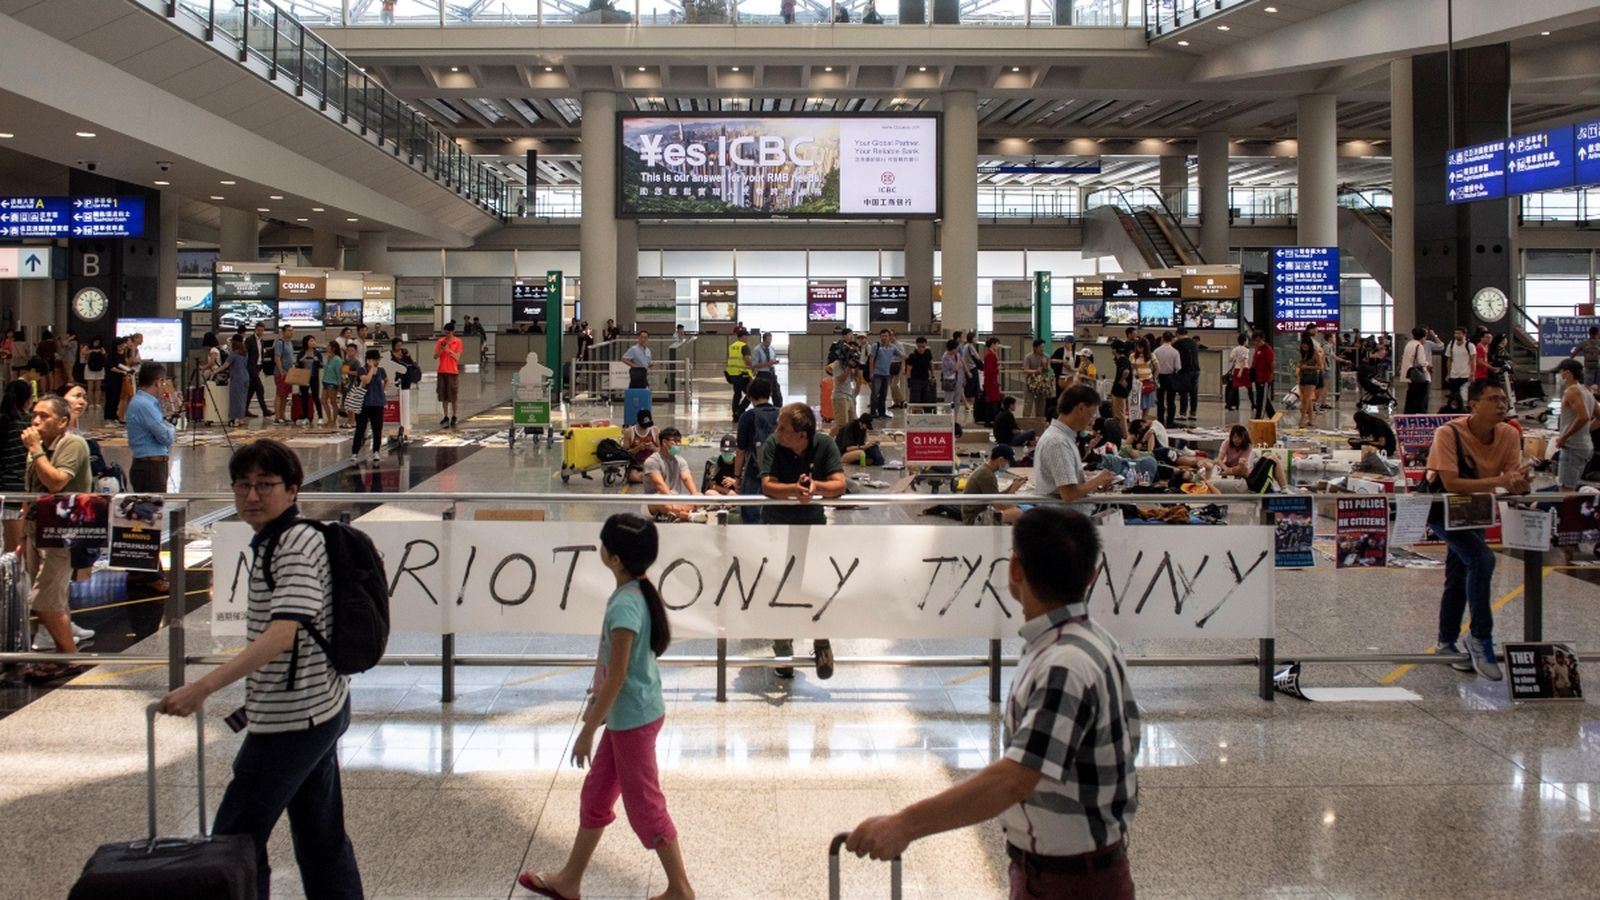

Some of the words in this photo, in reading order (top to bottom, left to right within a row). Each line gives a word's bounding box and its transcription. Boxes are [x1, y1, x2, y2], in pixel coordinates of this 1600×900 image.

[640, 172, 661, 183] This
[663, 172, 672, 182] is
[674, 174, 690, 182] our
[692, 174, 725, 183] answer
[727, 172, 741, 182] for
[743, 174, 764, 185] your
[767, 173, 789, 182] RMB
[35, 199, 45, 209] A
[113, 198, 118, 208] 1
[84, 253, 99, 277] B
[282, 282, 316, 290] CONRAD
[1397, 416, 1452, 428] WARNIN
[912, 436, 947, 445] QIMA
[1354, 499, 1385, 509] POLICE
[1350, 518, 1386, 526] CITIZENS
[658, 557, 860, 623] ONLY
[918, 550, 1269, 629] TYRNNY
[1509, 650, 1535, 665] THEY
